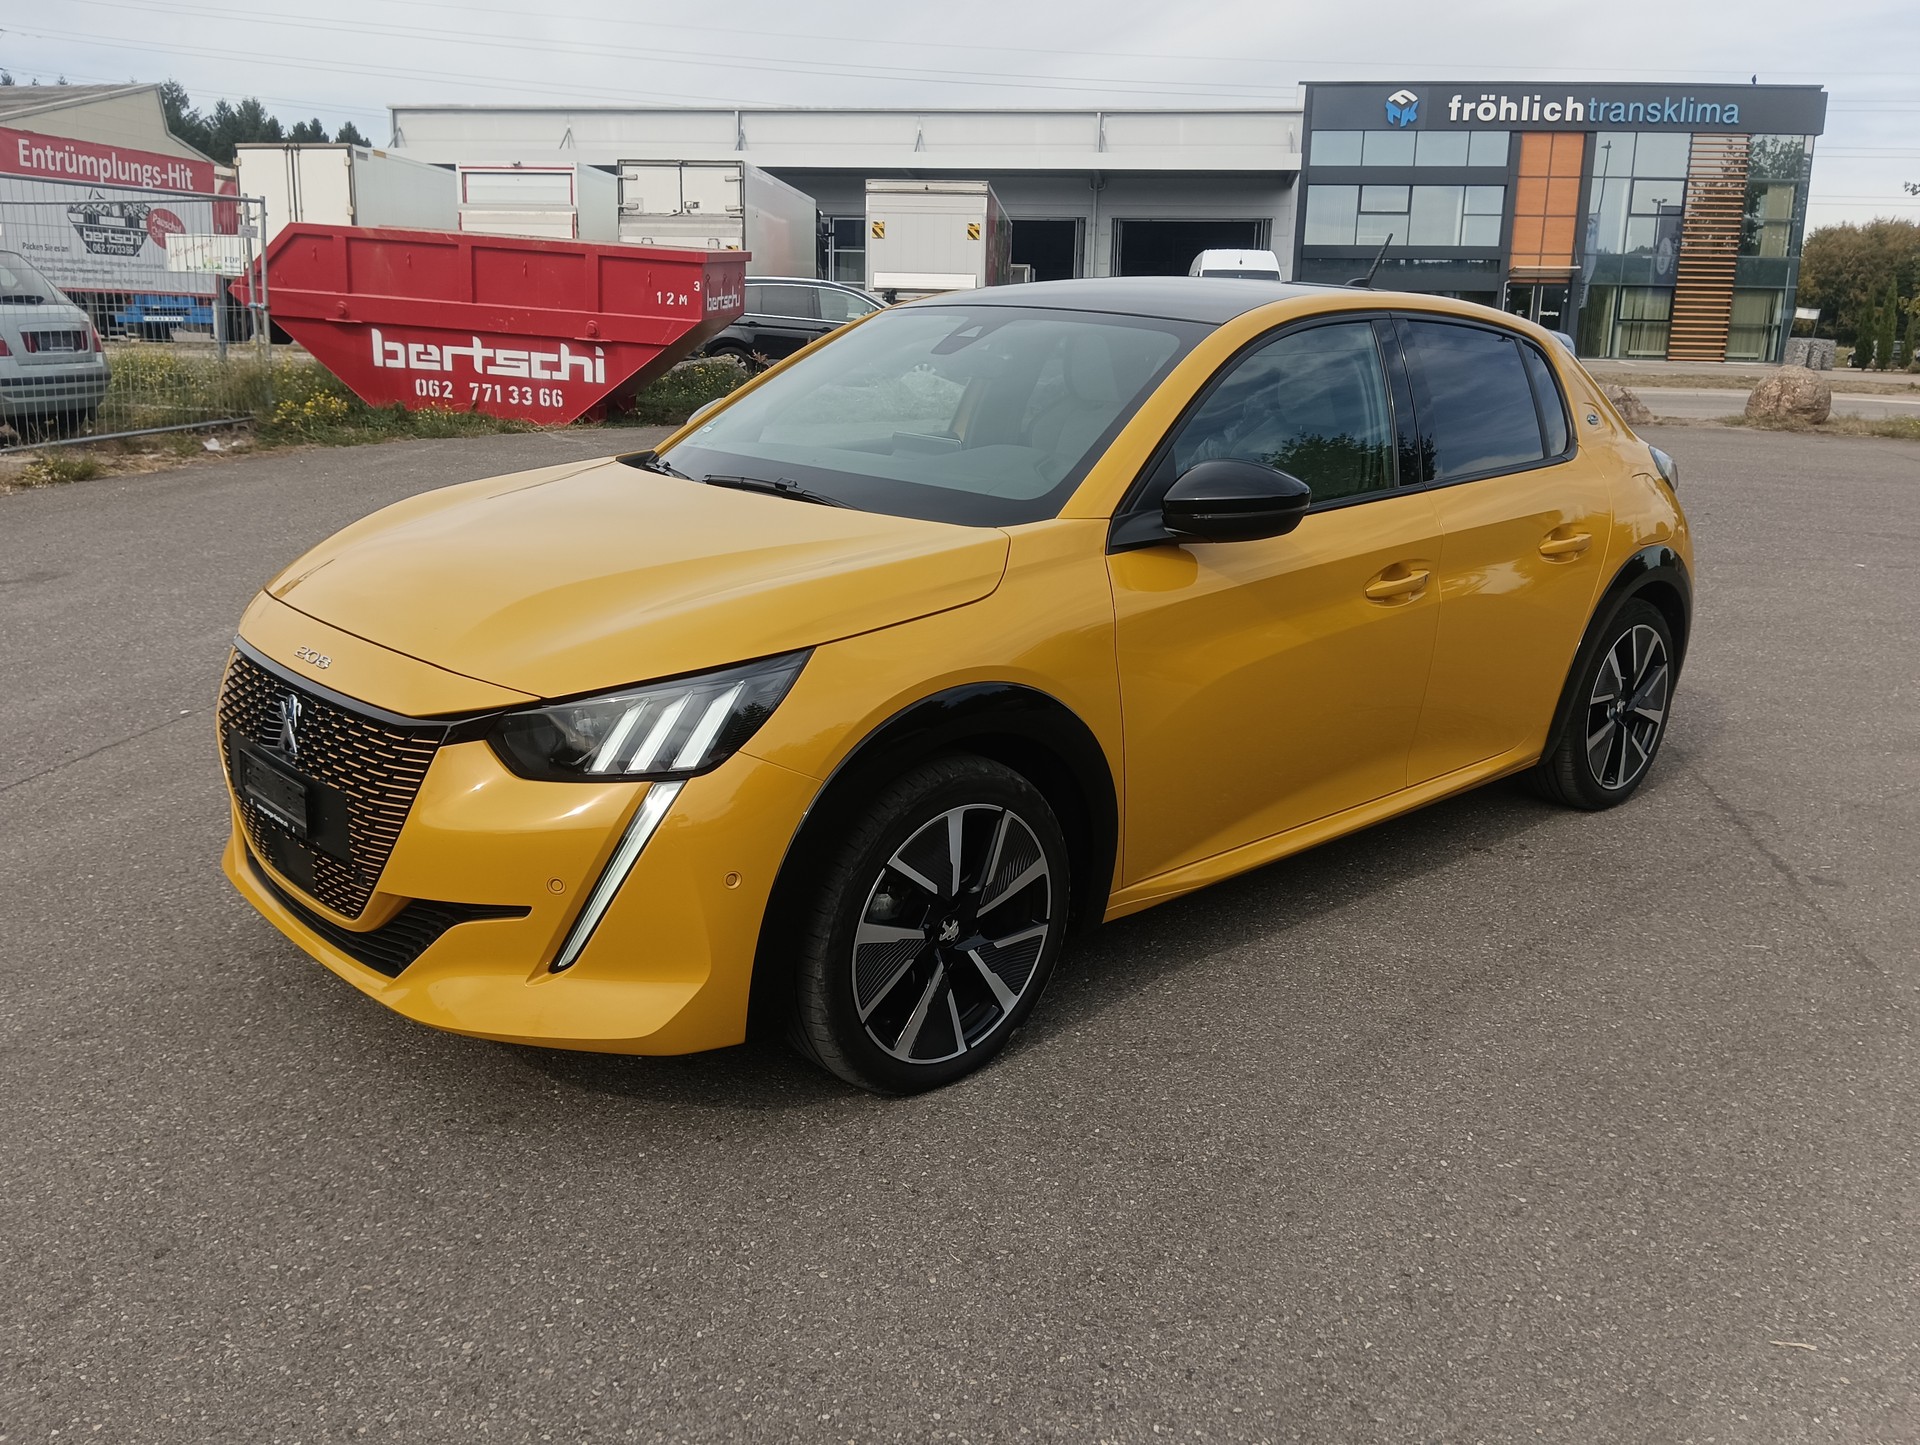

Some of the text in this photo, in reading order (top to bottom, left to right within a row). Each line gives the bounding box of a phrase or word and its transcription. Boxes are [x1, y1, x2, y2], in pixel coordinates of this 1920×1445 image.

[17, 138, 194, 190] Entrümplungs-Hit
[83, 227, 142, 245] bertschi
[92, 243, 105, 253] 062
[706, 284, 741, 312] bertschi
[371, 327, 606, 384] bertschi
[415, 378, 564, 408] 062 771 33 66
[294, 645, 333, 670] 208
